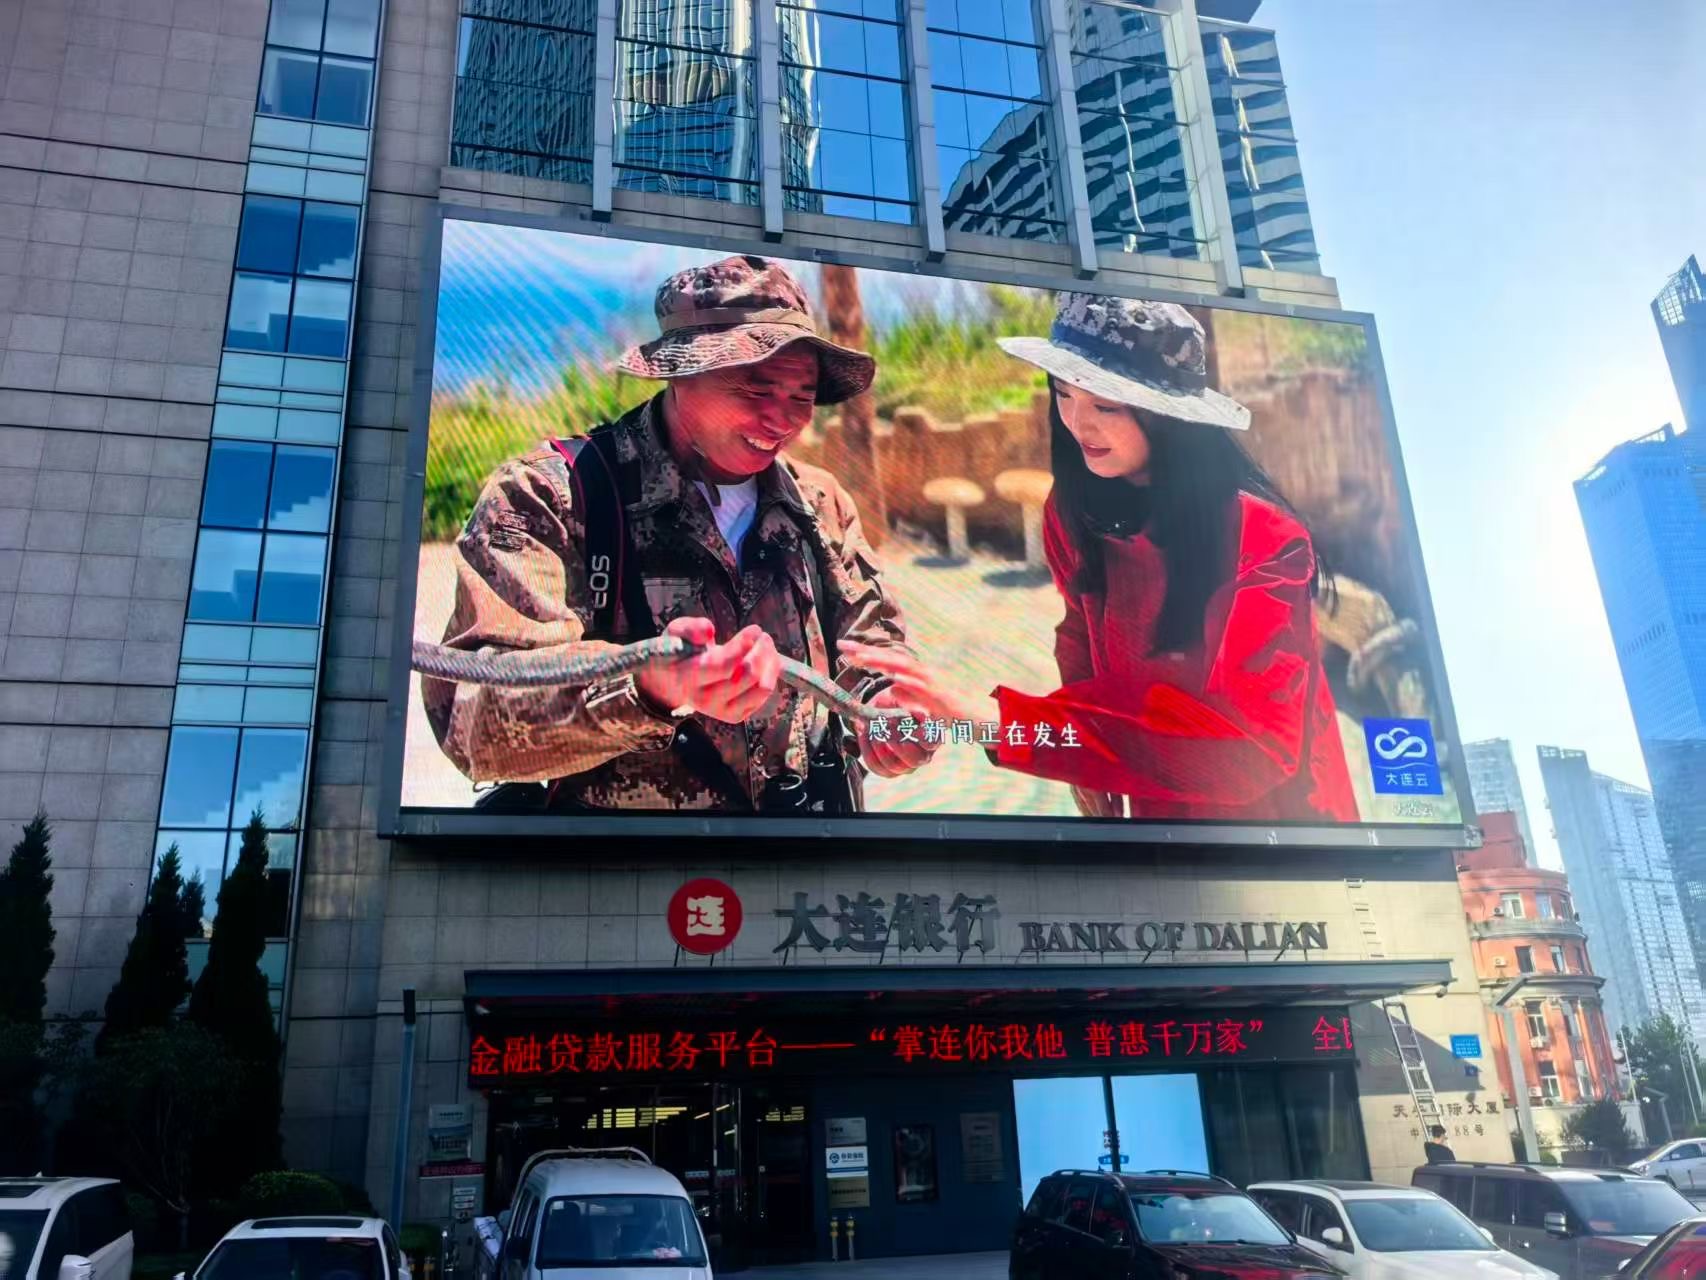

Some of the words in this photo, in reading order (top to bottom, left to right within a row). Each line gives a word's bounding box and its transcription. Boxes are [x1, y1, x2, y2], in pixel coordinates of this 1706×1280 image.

[868, 716, 1083, 748] 感受新闻正在发生
[1385, 773, 1428, 787] 大连云
[773, 892, 1000, 953] 大连银行
[1018, 922, 1131, 952] BANK
[1136, 921, 1185, 951] OF
[1194, 921, 1329, 951] DALIAN
[1311, 1015, 1353, 1050] 全
